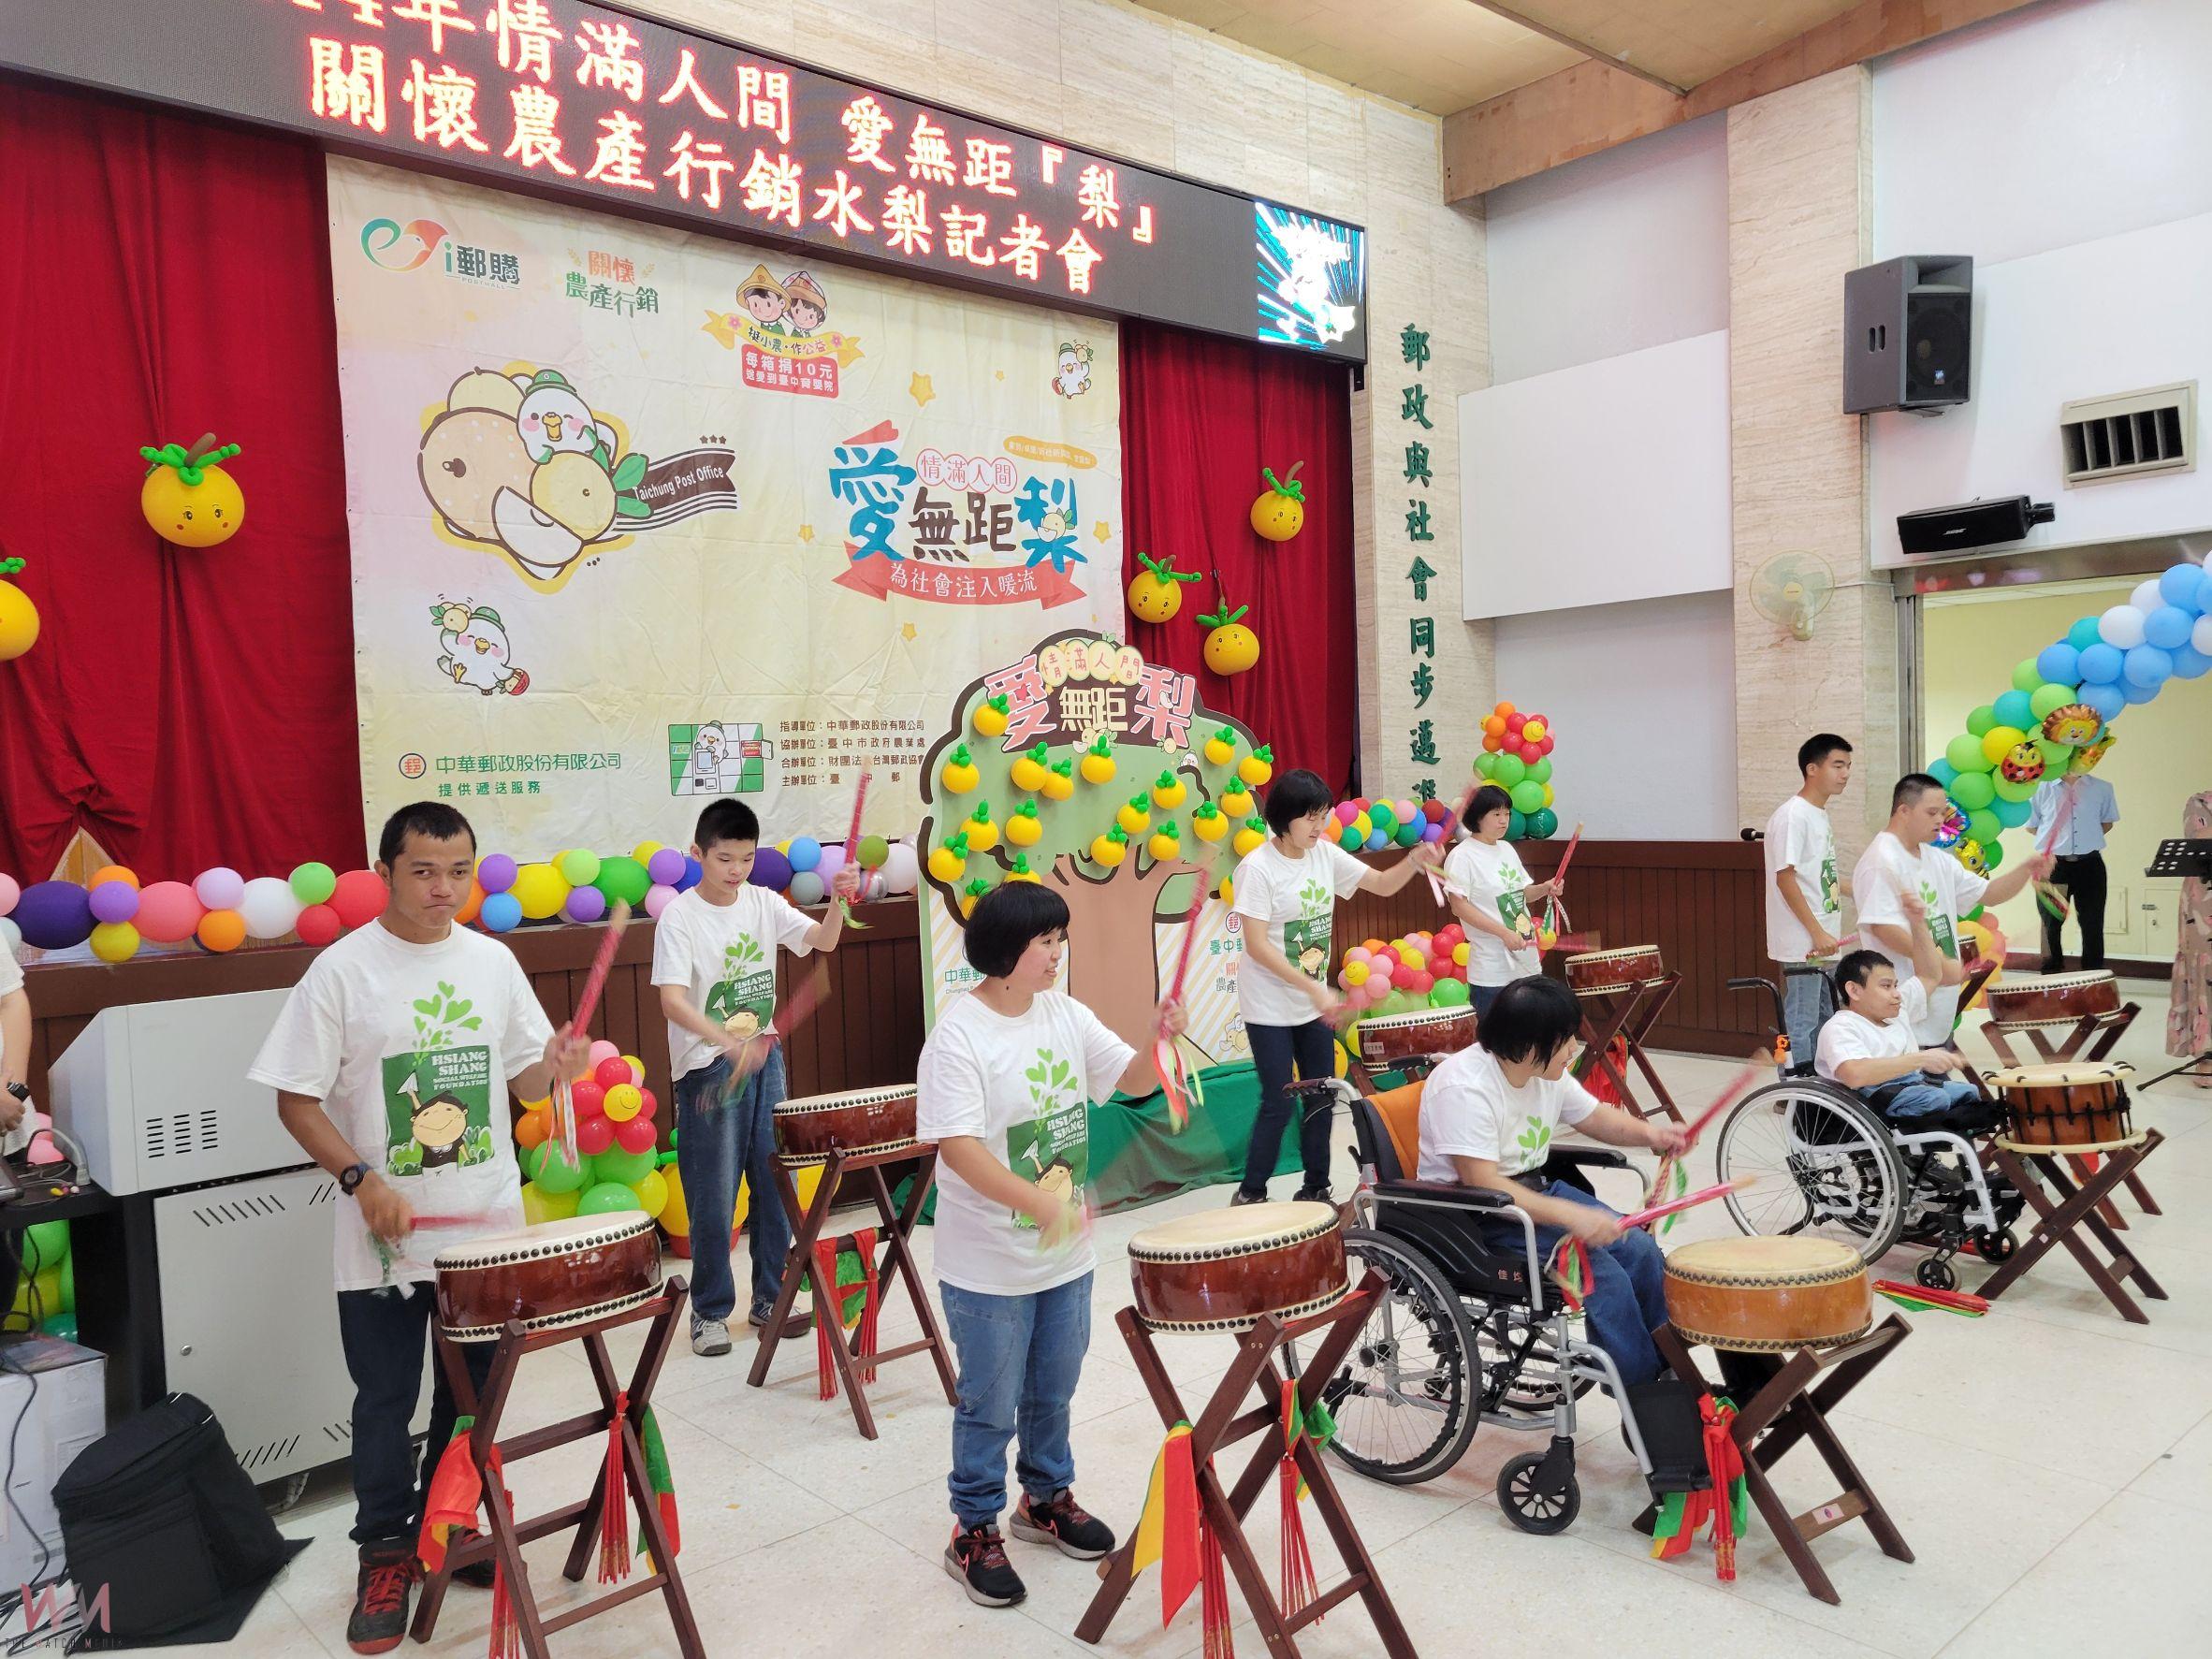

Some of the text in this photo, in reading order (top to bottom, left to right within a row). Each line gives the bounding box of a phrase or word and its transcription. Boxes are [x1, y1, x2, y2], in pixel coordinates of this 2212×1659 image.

[292, 0, 1155, 246] 年情滿人間 愛無距『梨』
[309, 36, 1105, 295] 關懷農產行銷水梨記者會
[588, 250, 636, 286] 關懷
[566, 270, 660, 318] 農產行銷
[745, 351, 833, 380] 每箱捐10元
[633, 464, 724, 501] Taichung Post Office
[921, 454, 1012, 488] 情滿人間
[829, 419, 1088, 574] 愛無距梨
[890, 562, 1038, 599] 為社會注入暖流
[1041, 647, 1142, 680] 情滿人間
[436, 752, 622, 775] 中華郵政股份有限公司
[781, 754, 924, 769] 合辦單位：財團法台灣郵政協會
[439, 780, 542, 797] 提供遞送服務
[734, 973, 772, 990] HSIANG
[431, 1051, 488, 1066] HSIANG
[439, 1062, 487, 1076] SHANG
